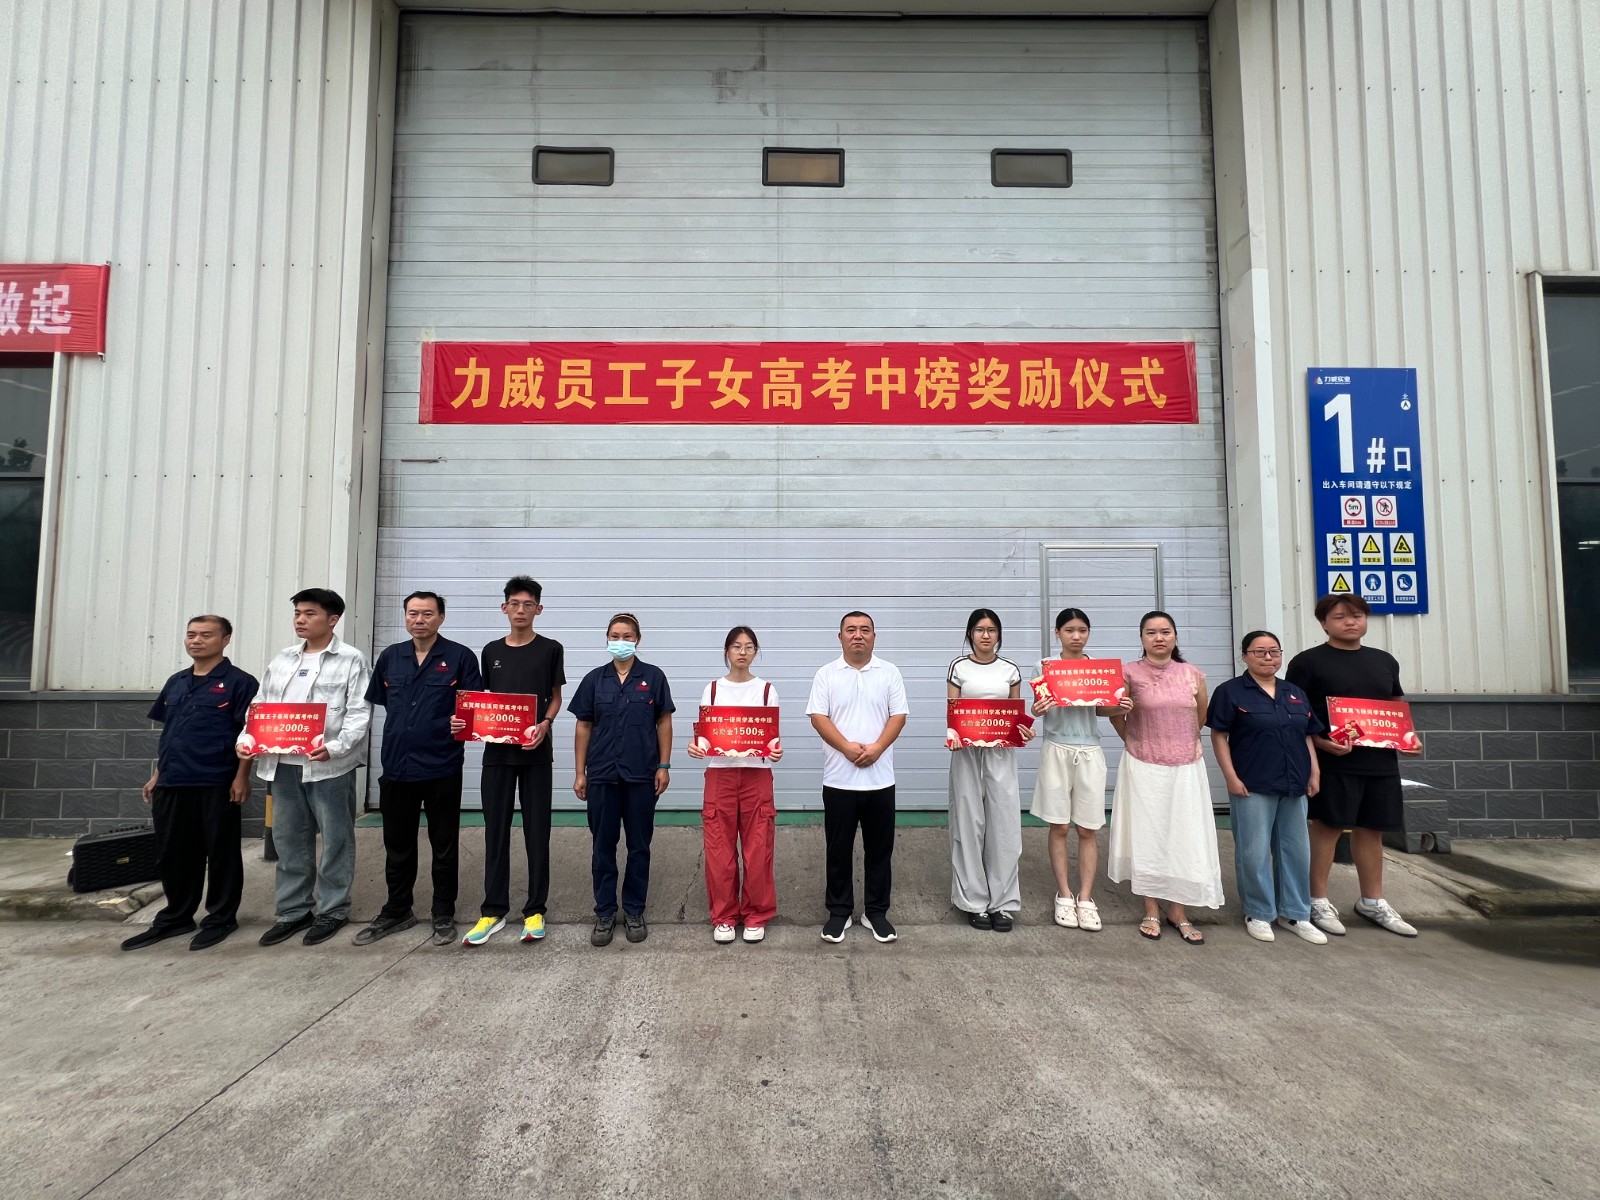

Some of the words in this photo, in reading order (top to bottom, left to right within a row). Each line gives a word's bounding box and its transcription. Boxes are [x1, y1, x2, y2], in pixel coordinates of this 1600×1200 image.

[450, 356, 1168, 411] 力威员工子女高考中榜奖励仪式
[1322, 480, 1412, 490] 出入车间请遵守以下规定
